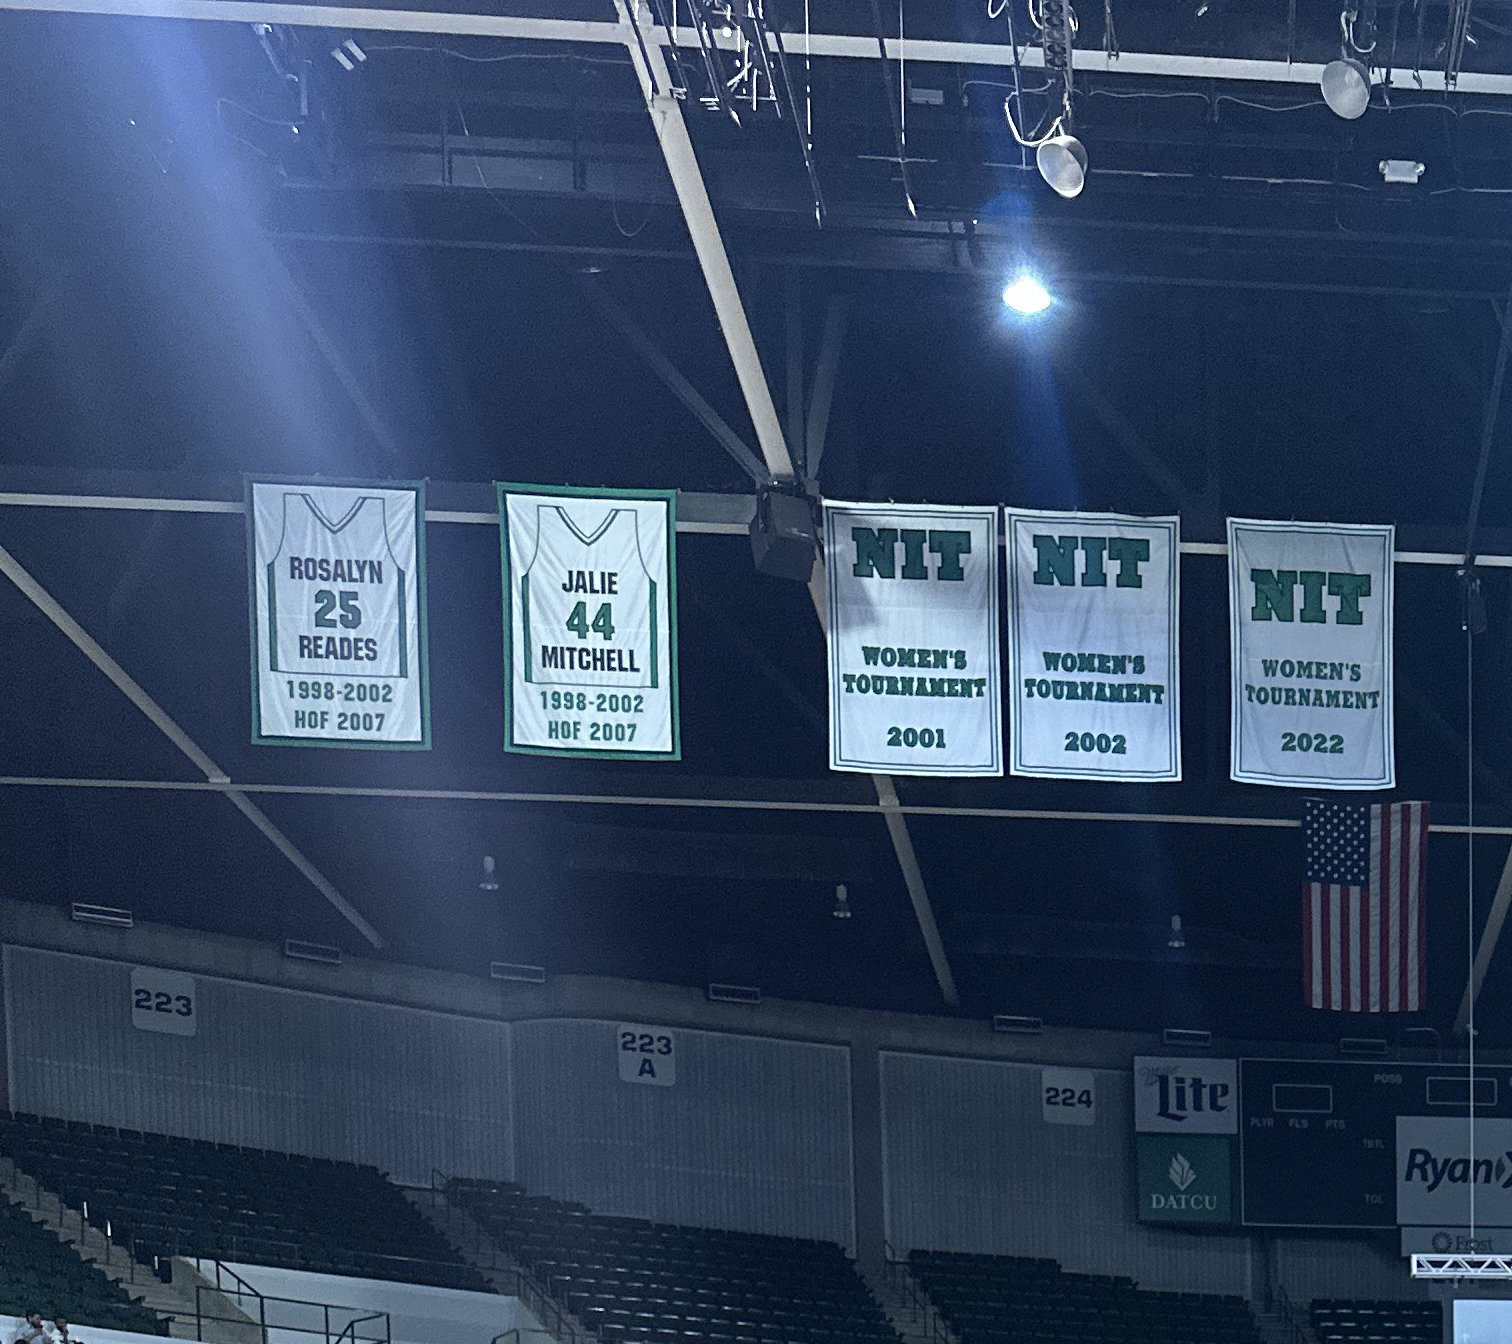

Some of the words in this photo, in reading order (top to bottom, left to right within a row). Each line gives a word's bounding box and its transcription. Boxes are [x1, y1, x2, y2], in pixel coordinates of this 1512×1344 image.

[851, 526, 972, 582] NIT
[1032, 533, 1151, 589] NIT
[289, 556, 384, 586] ROSALYN
[561, 569, 619, 596] JALIE
[313, 590, 362, 629] 25
[1250, 568, 1372, 626] NIT
[565, 601, 616, 641] 44
[298, 634, 378, 662] READES
[541, 644, 641, 674] MITCHELL
[861, 645, 967, 671] WOMEN'S
[1042, 650, 1145, 676] WOMEN'S
[1261, 658, 1363, 683] WOMEN'S
[286, 679, 393, 703] 1998-2002
[842, 672, 987, 698] TOURNAMENT
[1024, 677, 1165, 705] TOURNAMENT
[1244, 683, 1381, 711] TOURNAMENT
[540, 690, 645, 715] 1998-2002
[294, 710, 329, 730] HOF
[336, 711, 386, 733] 2007
[548, 721, 583, 741] HOF
[589, 722, 638, 744] 2007
[886, 726, 946, 749] 2001
[1063, 731, 1127, 755] 2002
[1280, 731, 1345, 755] 2022
[134, 989, 193, 1018] 223
[620, 1031, 673, 1056] 223
[637, 1057, 657, 1079] A
[1044, 1085, 1093, 1111] 224
[1156, 1074, 1229, 1121] Lite
[1250, 1117, 1275, 1129] PLYR
[1325, 1119, 1346, 1130] PTS
[1405, 1147, 1493, 1193] Ryan
[1151, 1193, 1217, 1211] DATCU
[1455, 1234, 1493, 1252] Frost
